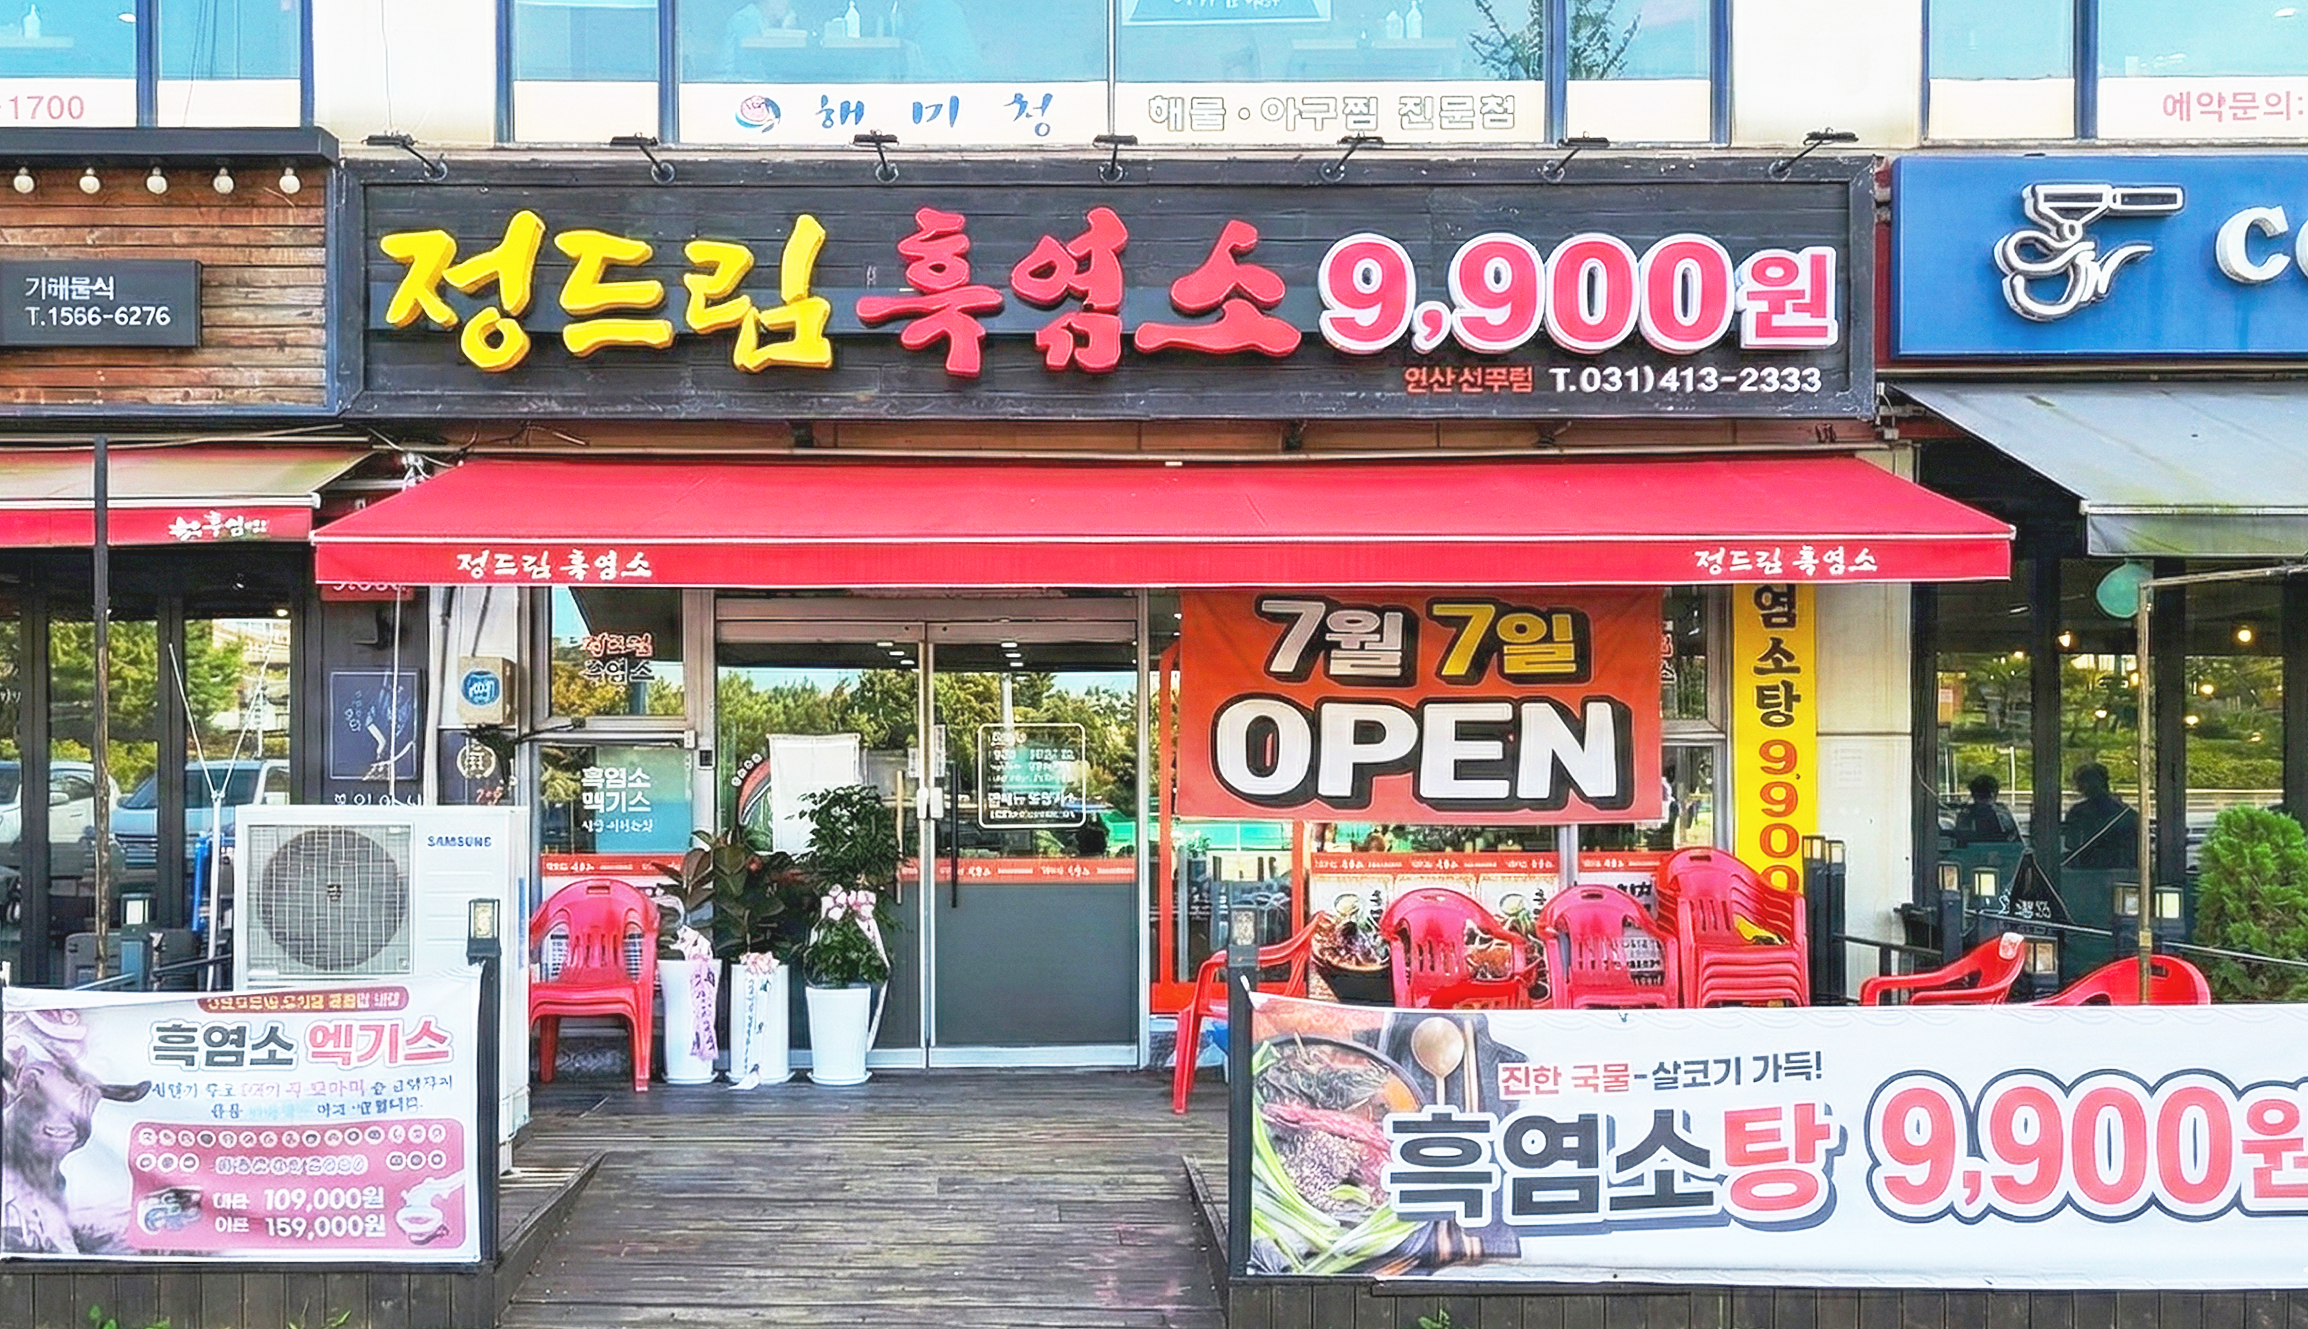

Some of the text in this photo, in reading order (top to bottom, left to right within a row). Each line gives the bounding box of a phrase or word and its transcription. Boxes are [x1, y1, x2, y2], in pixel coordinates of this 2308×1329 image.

[0, 95, 84, 120] 1700
[2214, 205, 2308, 284] C
[380, 207, 1839, 377] 정드림 흑염소 9,900원
[25, 306, 171, 326] T.1566-6276
[456, 548, 653, 581] 정드림 흑염소
[1694, 544, 1878, 577] 정드림 흑염소
[1258, 597, 1405, 680] 7월
[1431, 600, 1579, 680] 7일
[1213, 696, 1619, 801] OPEN
[581, 766, 651, 789] 흑염소
[152, 1018, 451, 1068] 흑염소 엑기스
[1501, 1063, 1562, 1095] 진한
[1752, 1051, 1823, 1086] 가득!
[1389, 1103, 1832, 1220] 흑염소탕
[264, 1186, 385, 1212] 109,000원
[265, 1214, 387, 1241] 159,000원
